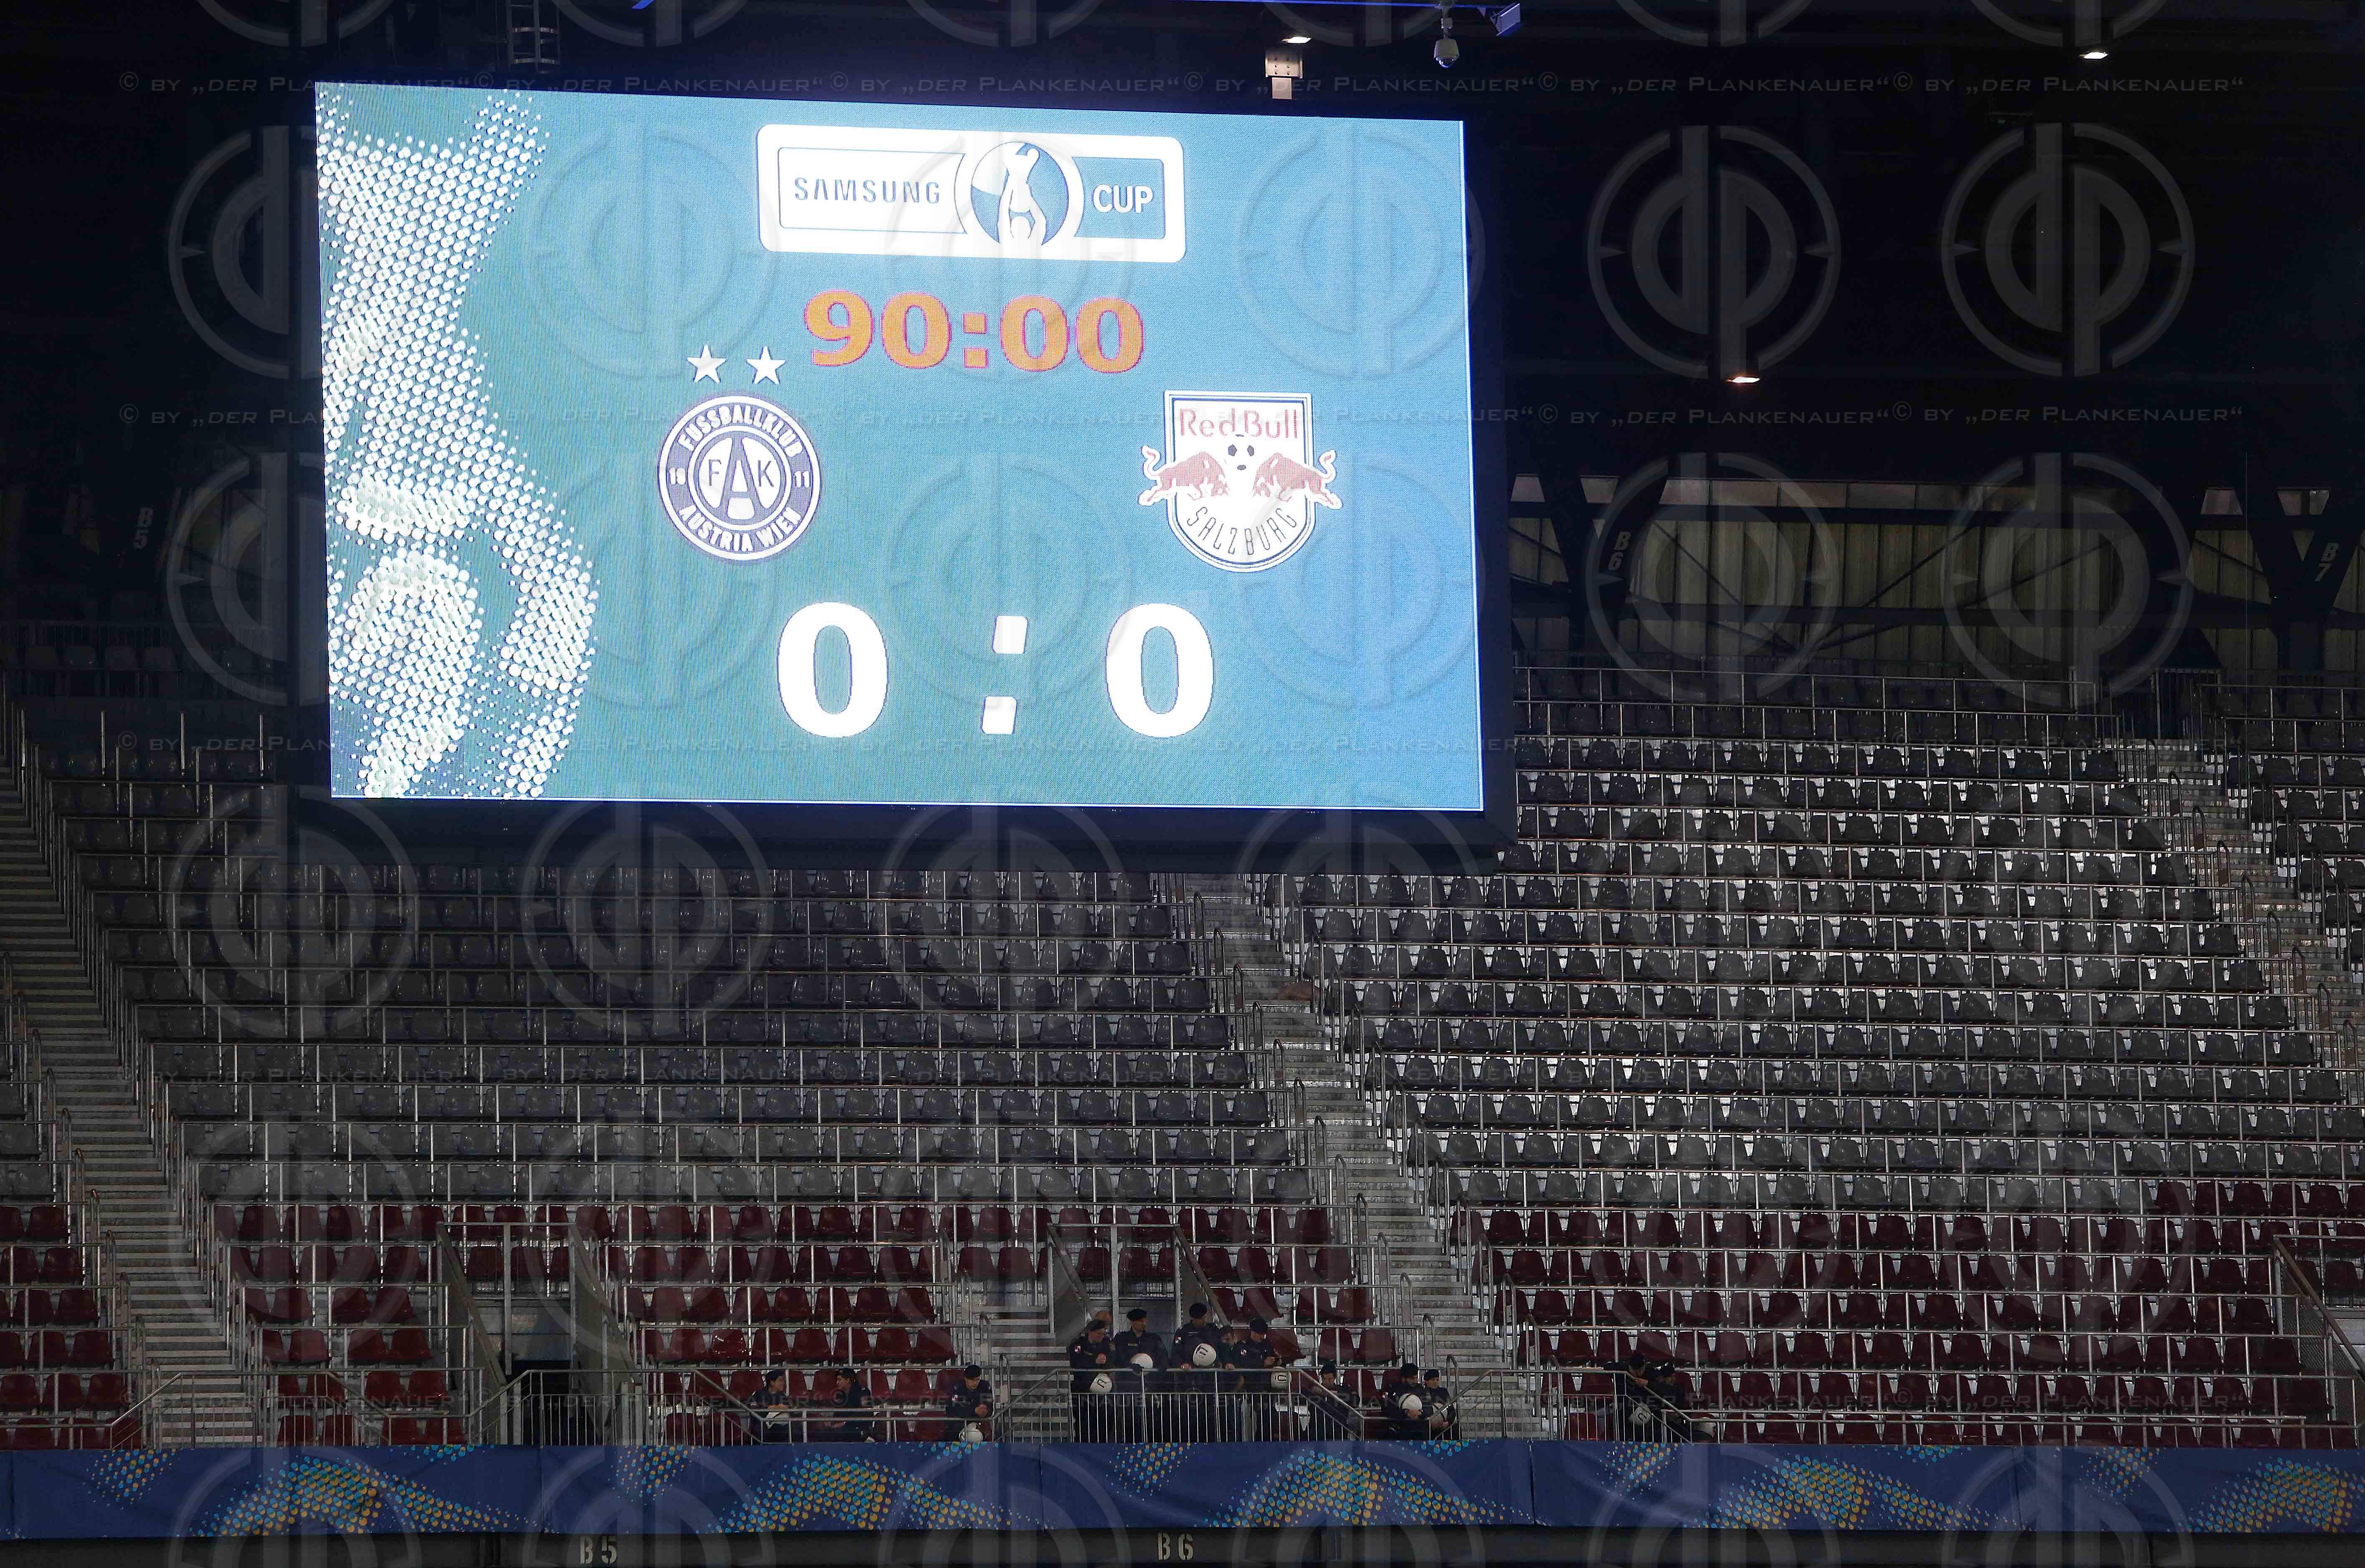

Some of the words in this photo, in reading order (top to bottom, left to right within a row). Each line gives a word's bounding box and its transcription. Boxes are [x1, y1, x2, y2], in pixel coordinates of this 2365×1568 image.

[794, 177, 940, 204] SAMSUNG
[1093, 184, 1153, 214] CUP
[804, 289, 1144, 374] 90:00
[678, 404, 803, 458] FUSSBALLKLUB
[1180, 408, 1235, 437] Red
[1245, 409, 1297, 438] Bull
[679, 504, 753, 552] AUSTRIA
[755, 507, 802, 548] WIEN
[1187, 507, 1297, 555] SALZBURG
